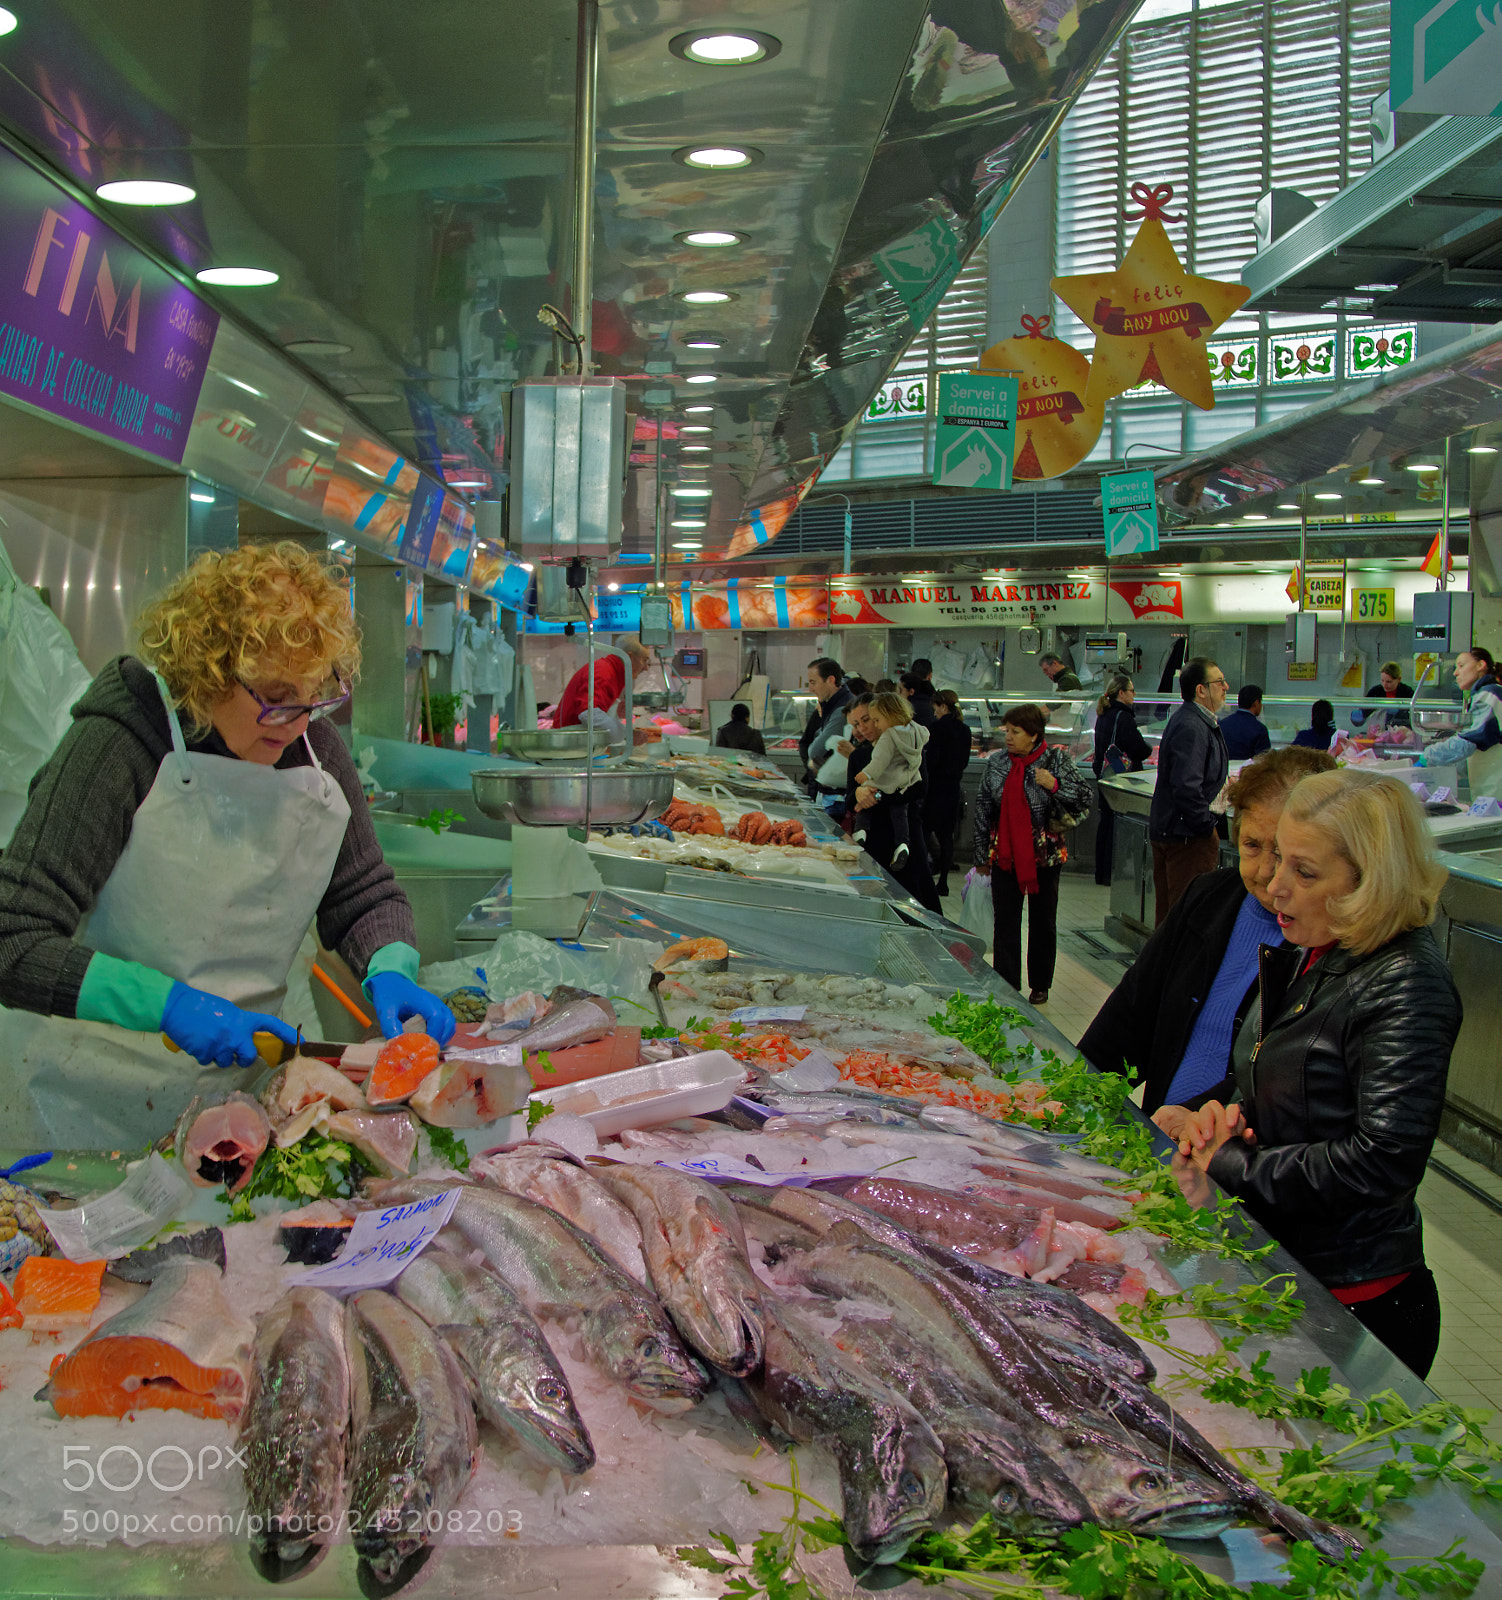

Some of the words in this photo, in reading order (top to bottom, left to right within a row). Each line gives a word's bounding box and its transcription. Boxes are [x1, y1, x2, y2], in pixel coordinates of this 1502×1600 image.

[22, 206, 142, 354] FINA
[1133, 284, 1183, 303] feliç
[168, 300, 189, 334] CASA
[1124, 315, 1153, 333] ANY
[1160, 308, 1190, 325] NOU
[164, 346, 177, 370] EN
[0, 323, 44, 387] HINAS
[40, 346, 64, 397] DE
[63, 357, 113, 419] COSECHA
[950, 383, 995, 400] Servei
[999, 391, 1008, 402] a
[1022, 376, 1058, 391] eliç
[949, 401, 1007, 418] domicili
[1036, 397, 1064, 411] NOU
[957, 418, 980, 426] ESPANYA
[984, 420, 1005, 428] EUROPA
[1109, 480, 1140, 493] Servei
[1142, 481, 1148, 489] a
[1110, 491, 1149, 505] domicili
[870, 586, 961, 604] MANUEL
[970, 582, 1092, 602] MARTINEZ
[1310, 581, 1342, 591] CABEZA
[1309, 595, 1342, 604] LOMO
[1359, 593, 1387, 616] 375
[376, 1190, 451, 1229] SALMON
